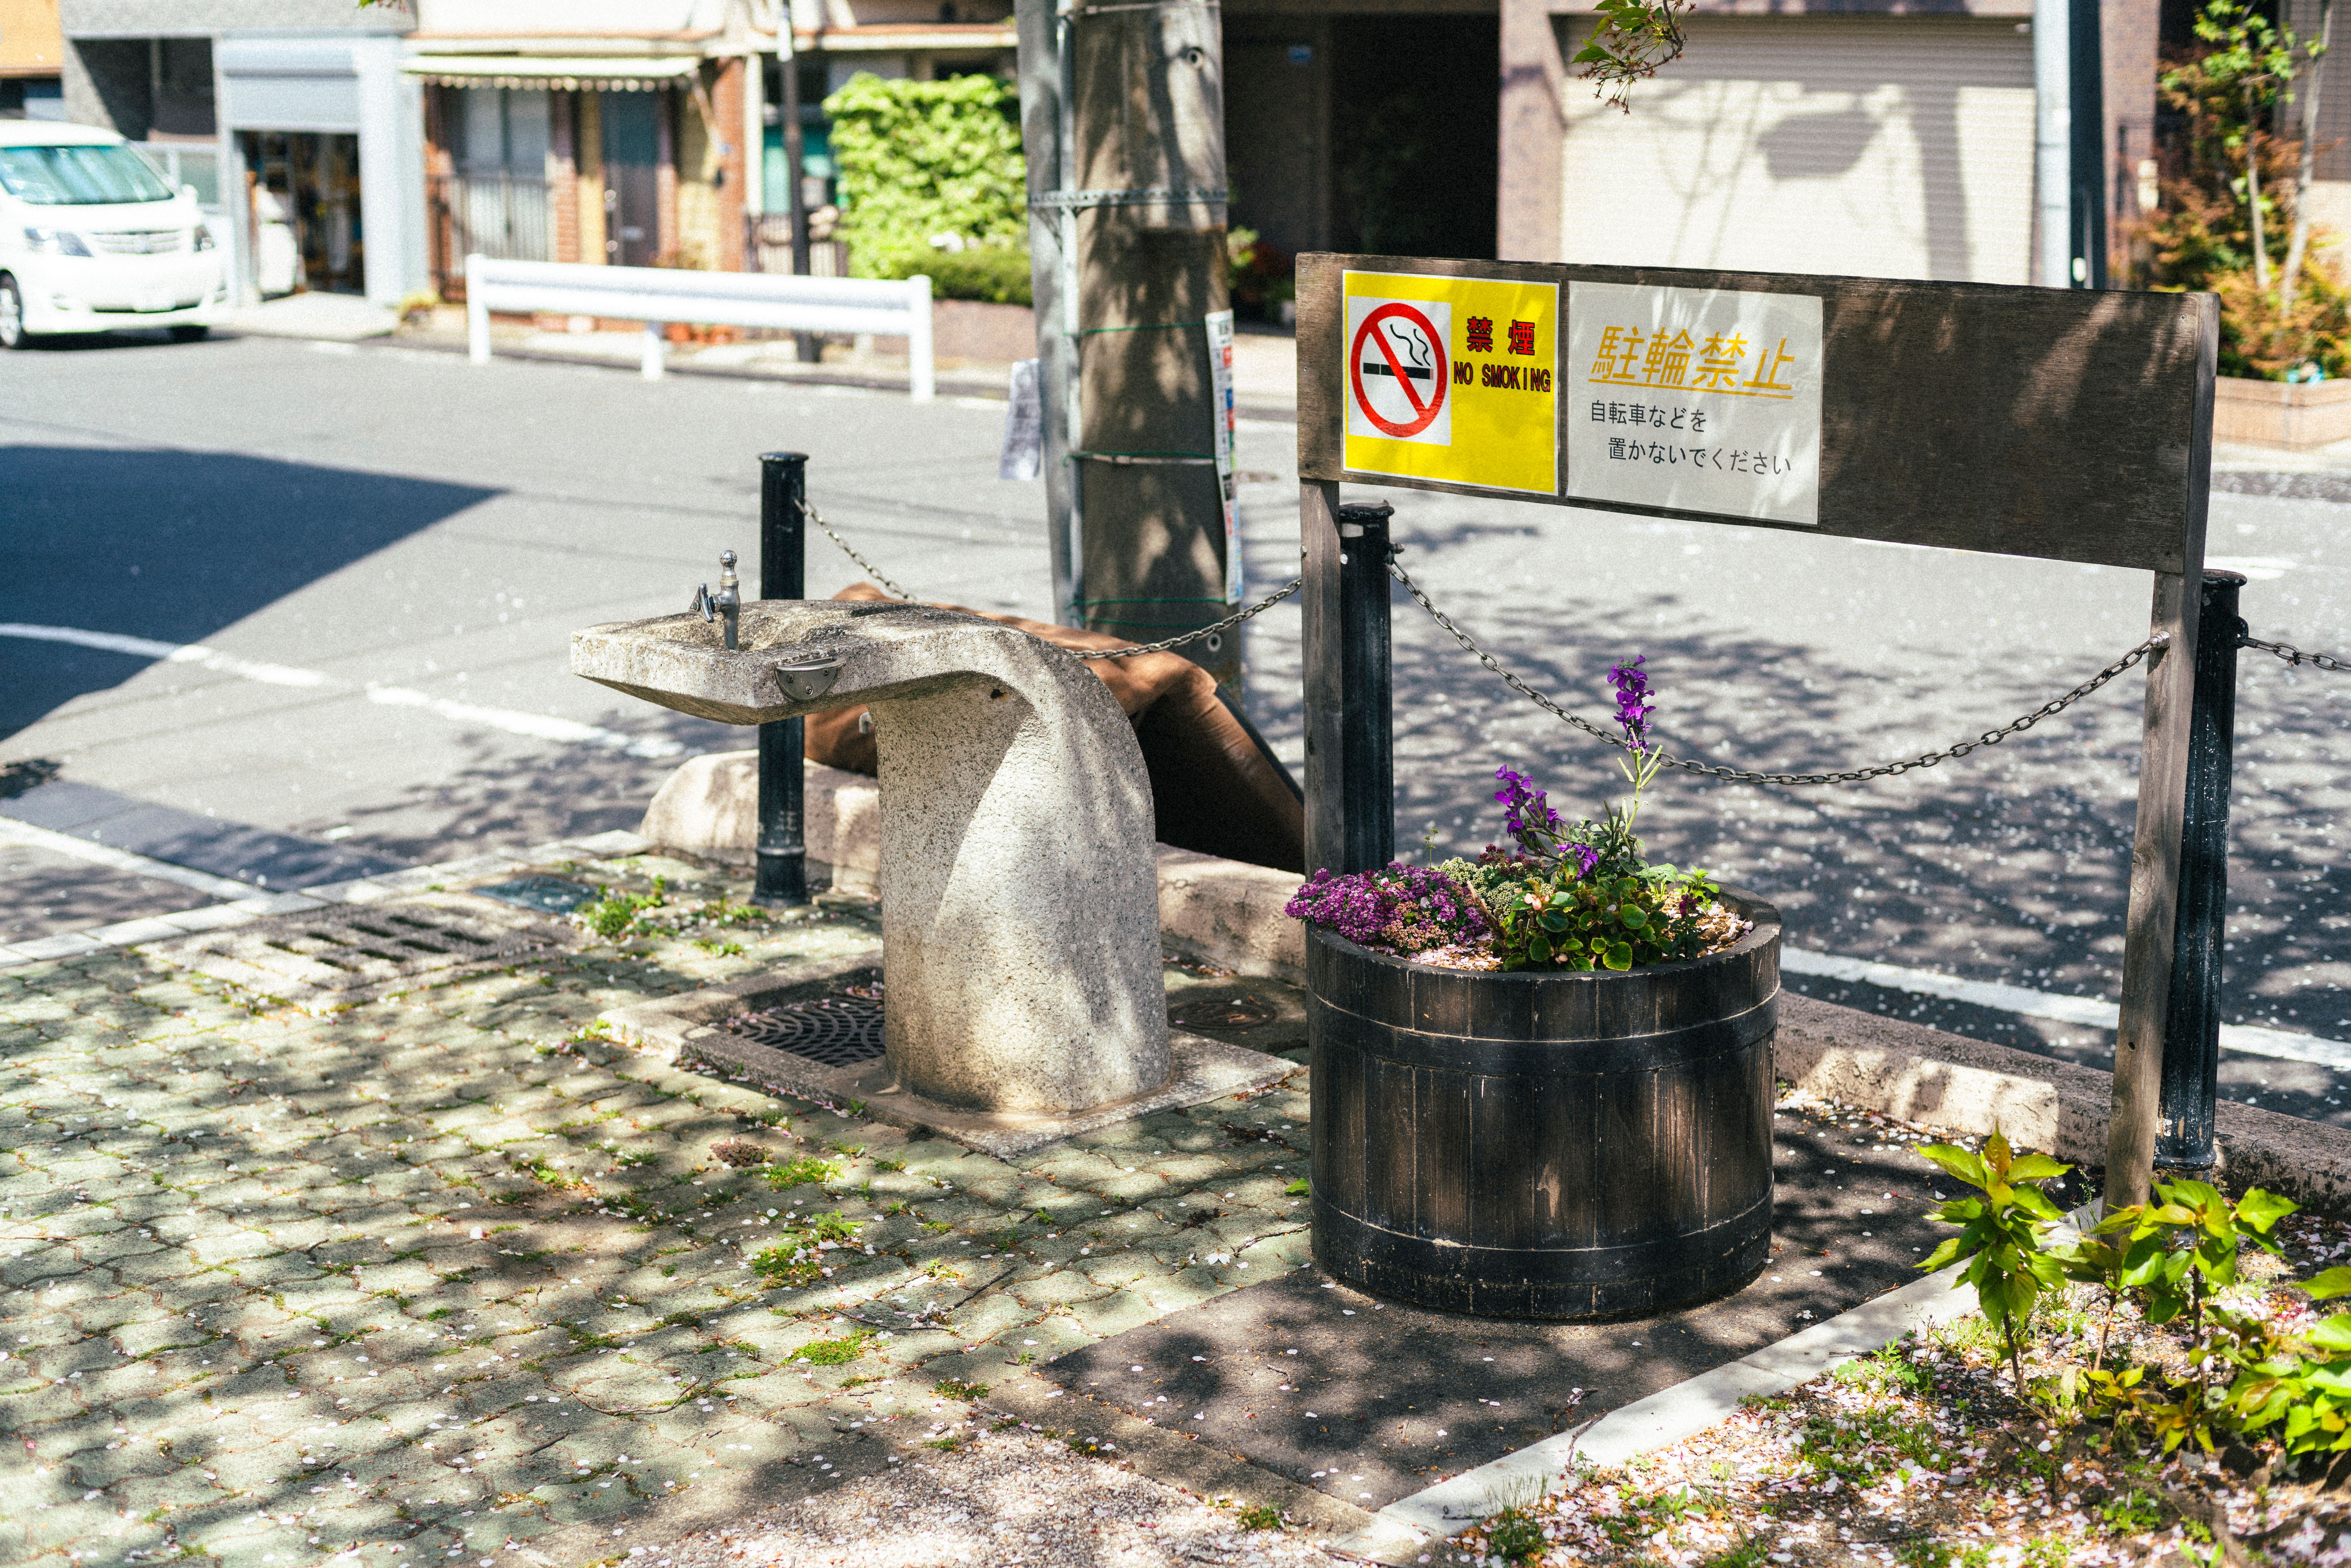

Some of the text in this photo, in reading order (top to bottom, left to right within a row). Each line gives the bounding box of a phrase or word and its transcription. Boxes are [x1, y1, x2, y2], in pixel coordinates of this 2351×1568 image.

[1467, 316, 1535, 355] 禁煙
[1454, 361, 1550, 392] NO SMOKING
[1591, 326, 1795, 390] 駐輪禁止
[1591, 400, 1707, 432] 自転車などを
[1608, 437, 1791, 475] 置かないでください
